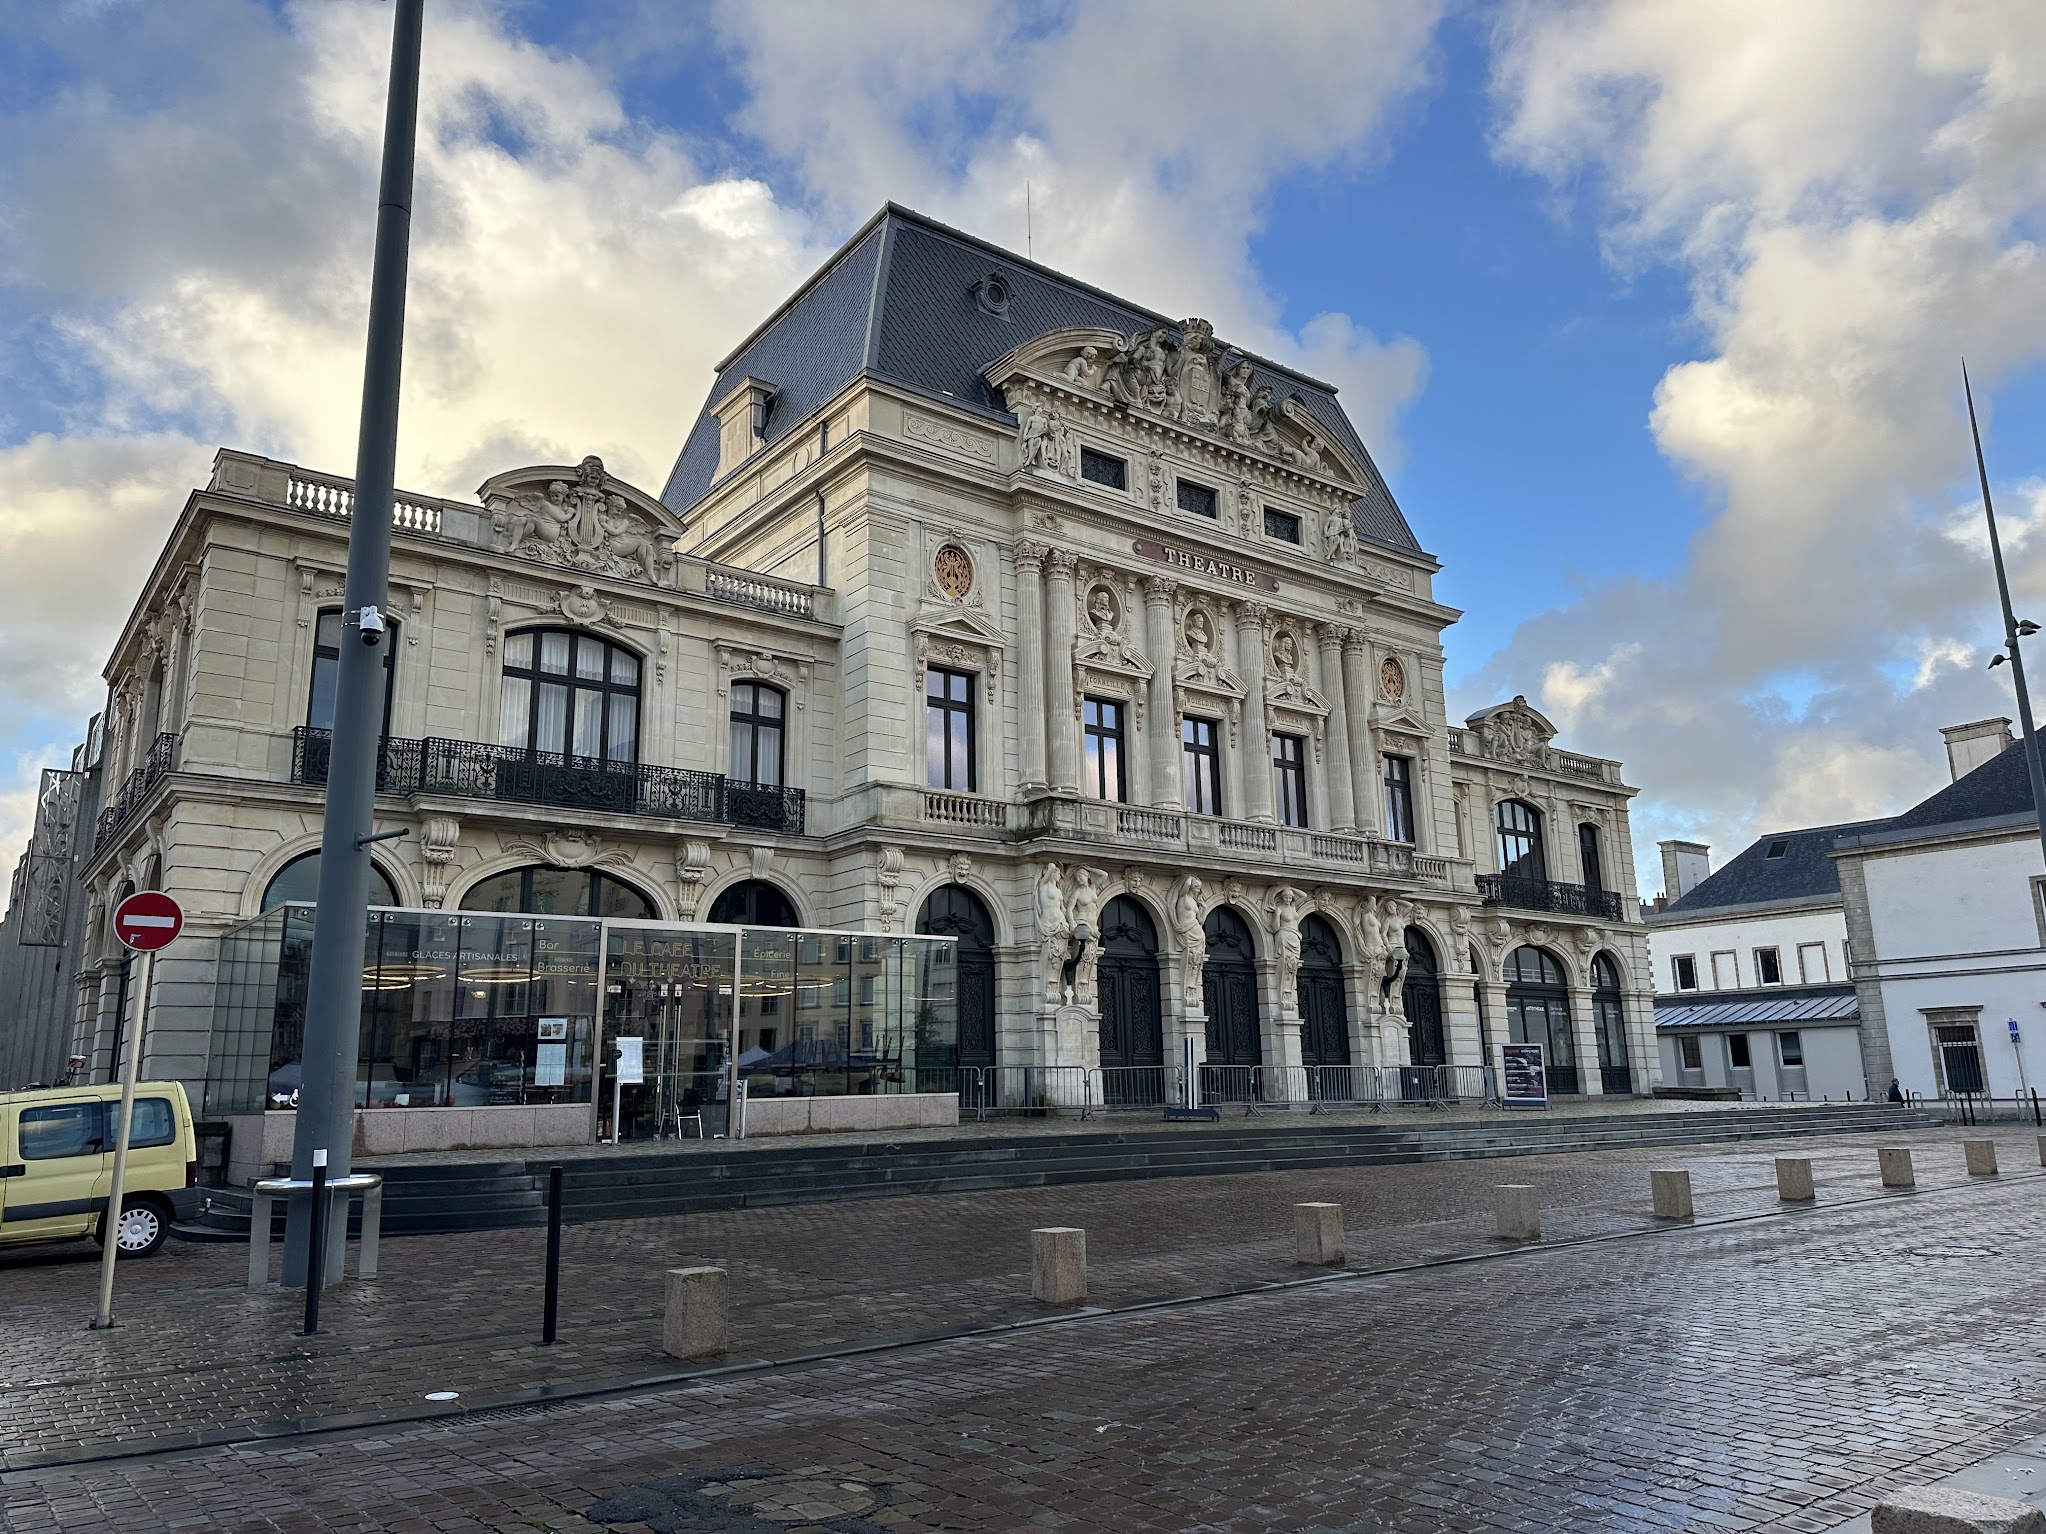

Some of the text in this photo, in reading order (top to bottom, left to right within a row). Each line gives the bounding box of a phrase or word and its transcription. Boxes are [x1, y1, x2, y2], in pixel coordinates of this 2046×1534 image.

[1164, 547, 1256, 585] THEATRE
[1089, 676, 1125, 690] CORNEILLE
[539, 940, 560, 950] Bar
[623, 940, 643, 955] LE
[412, 950, 451, 959] GLACES
[452, 952, 518, 962] ARTISANALES
[753, 947, 791, 960] Épicerie
[538, 962, 590, 973] Brasserie
[621, 962, 644, 977] DU
[770, 969, 790, 979] Fine
